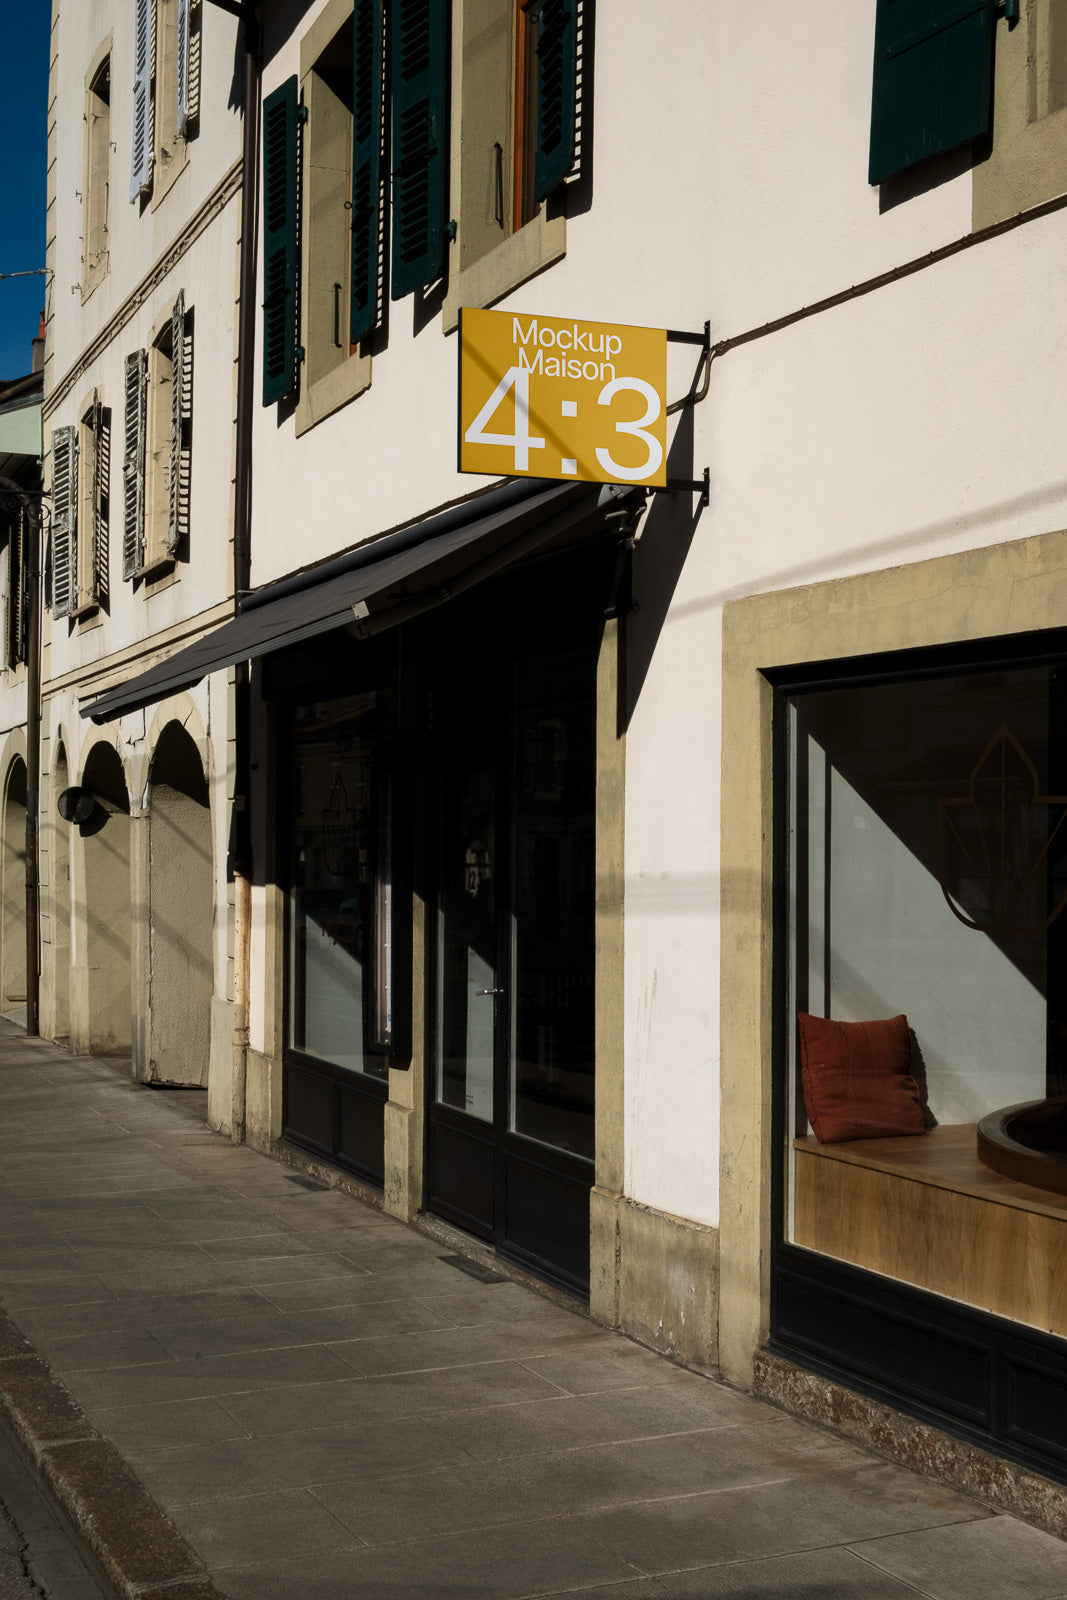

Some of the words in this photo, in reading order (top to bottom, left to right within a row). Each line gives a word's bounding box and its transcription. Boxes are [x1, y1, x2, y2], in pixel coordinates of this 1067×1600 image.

[512, 317, 623, 360] Mockup
[518, 347, 616, 381] Maison
[464, 366, 663, 481] 4:3
